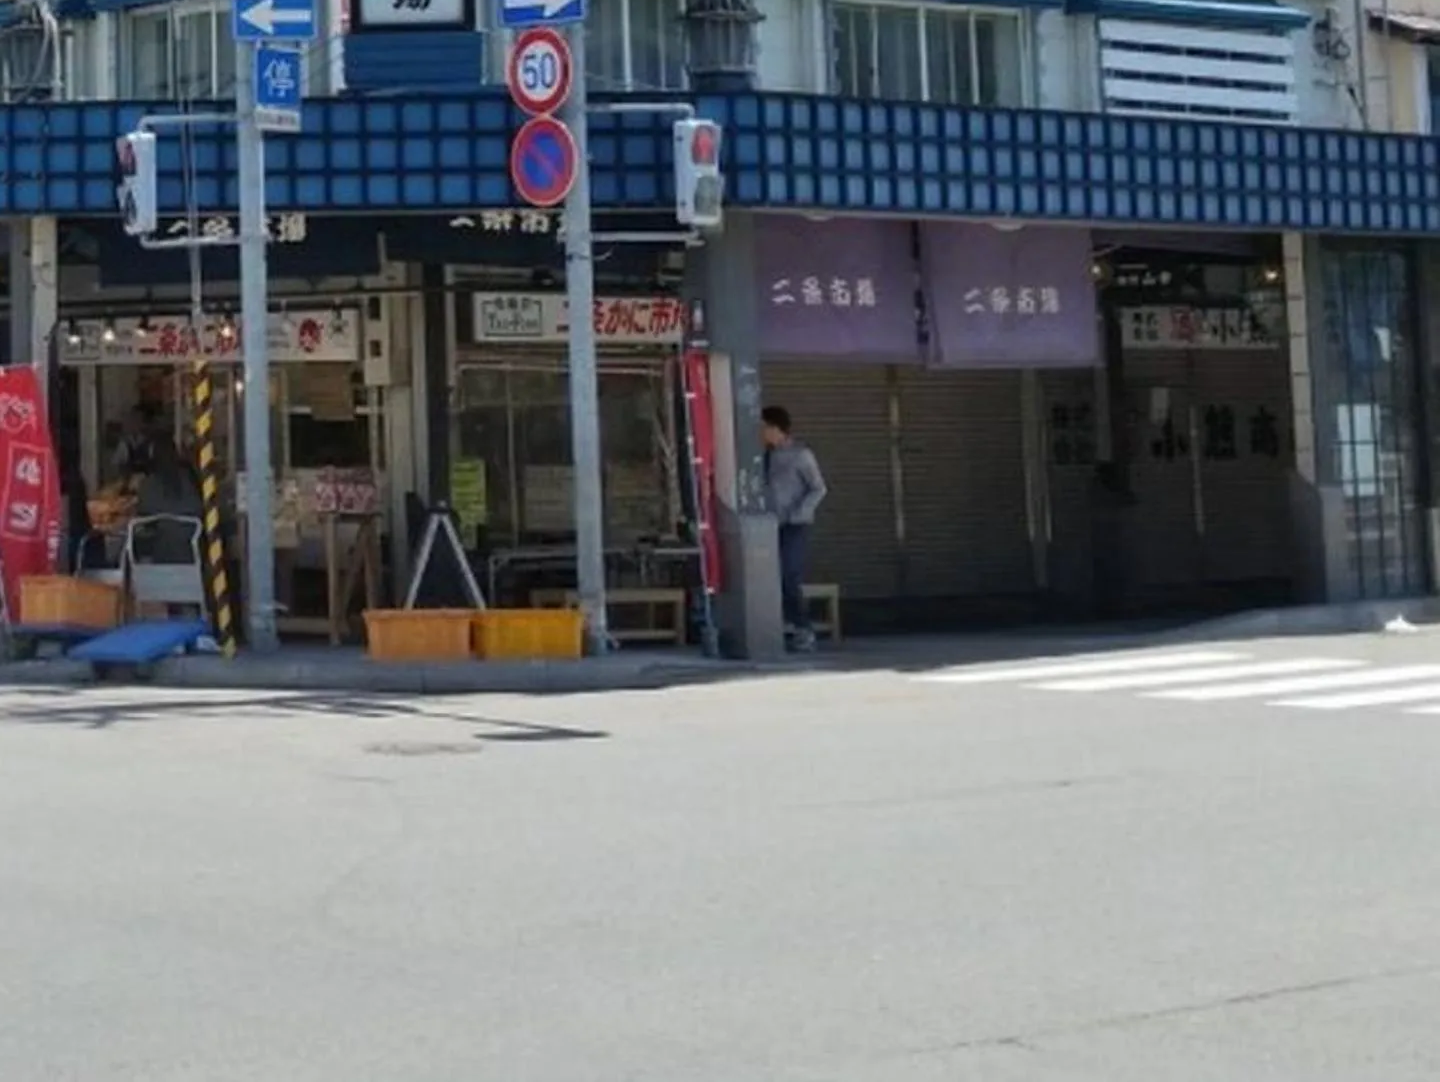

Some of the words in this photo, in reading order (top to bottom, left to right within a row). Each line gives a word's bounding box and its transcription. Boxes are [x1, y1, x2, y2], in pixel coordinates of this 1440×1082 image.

[264, 58, 295, 99] 停
[521, 51, 558, 91] 50
[771, 275, 877, 307] 二条市場
[963, 286, 1060, 315] 二条市場
